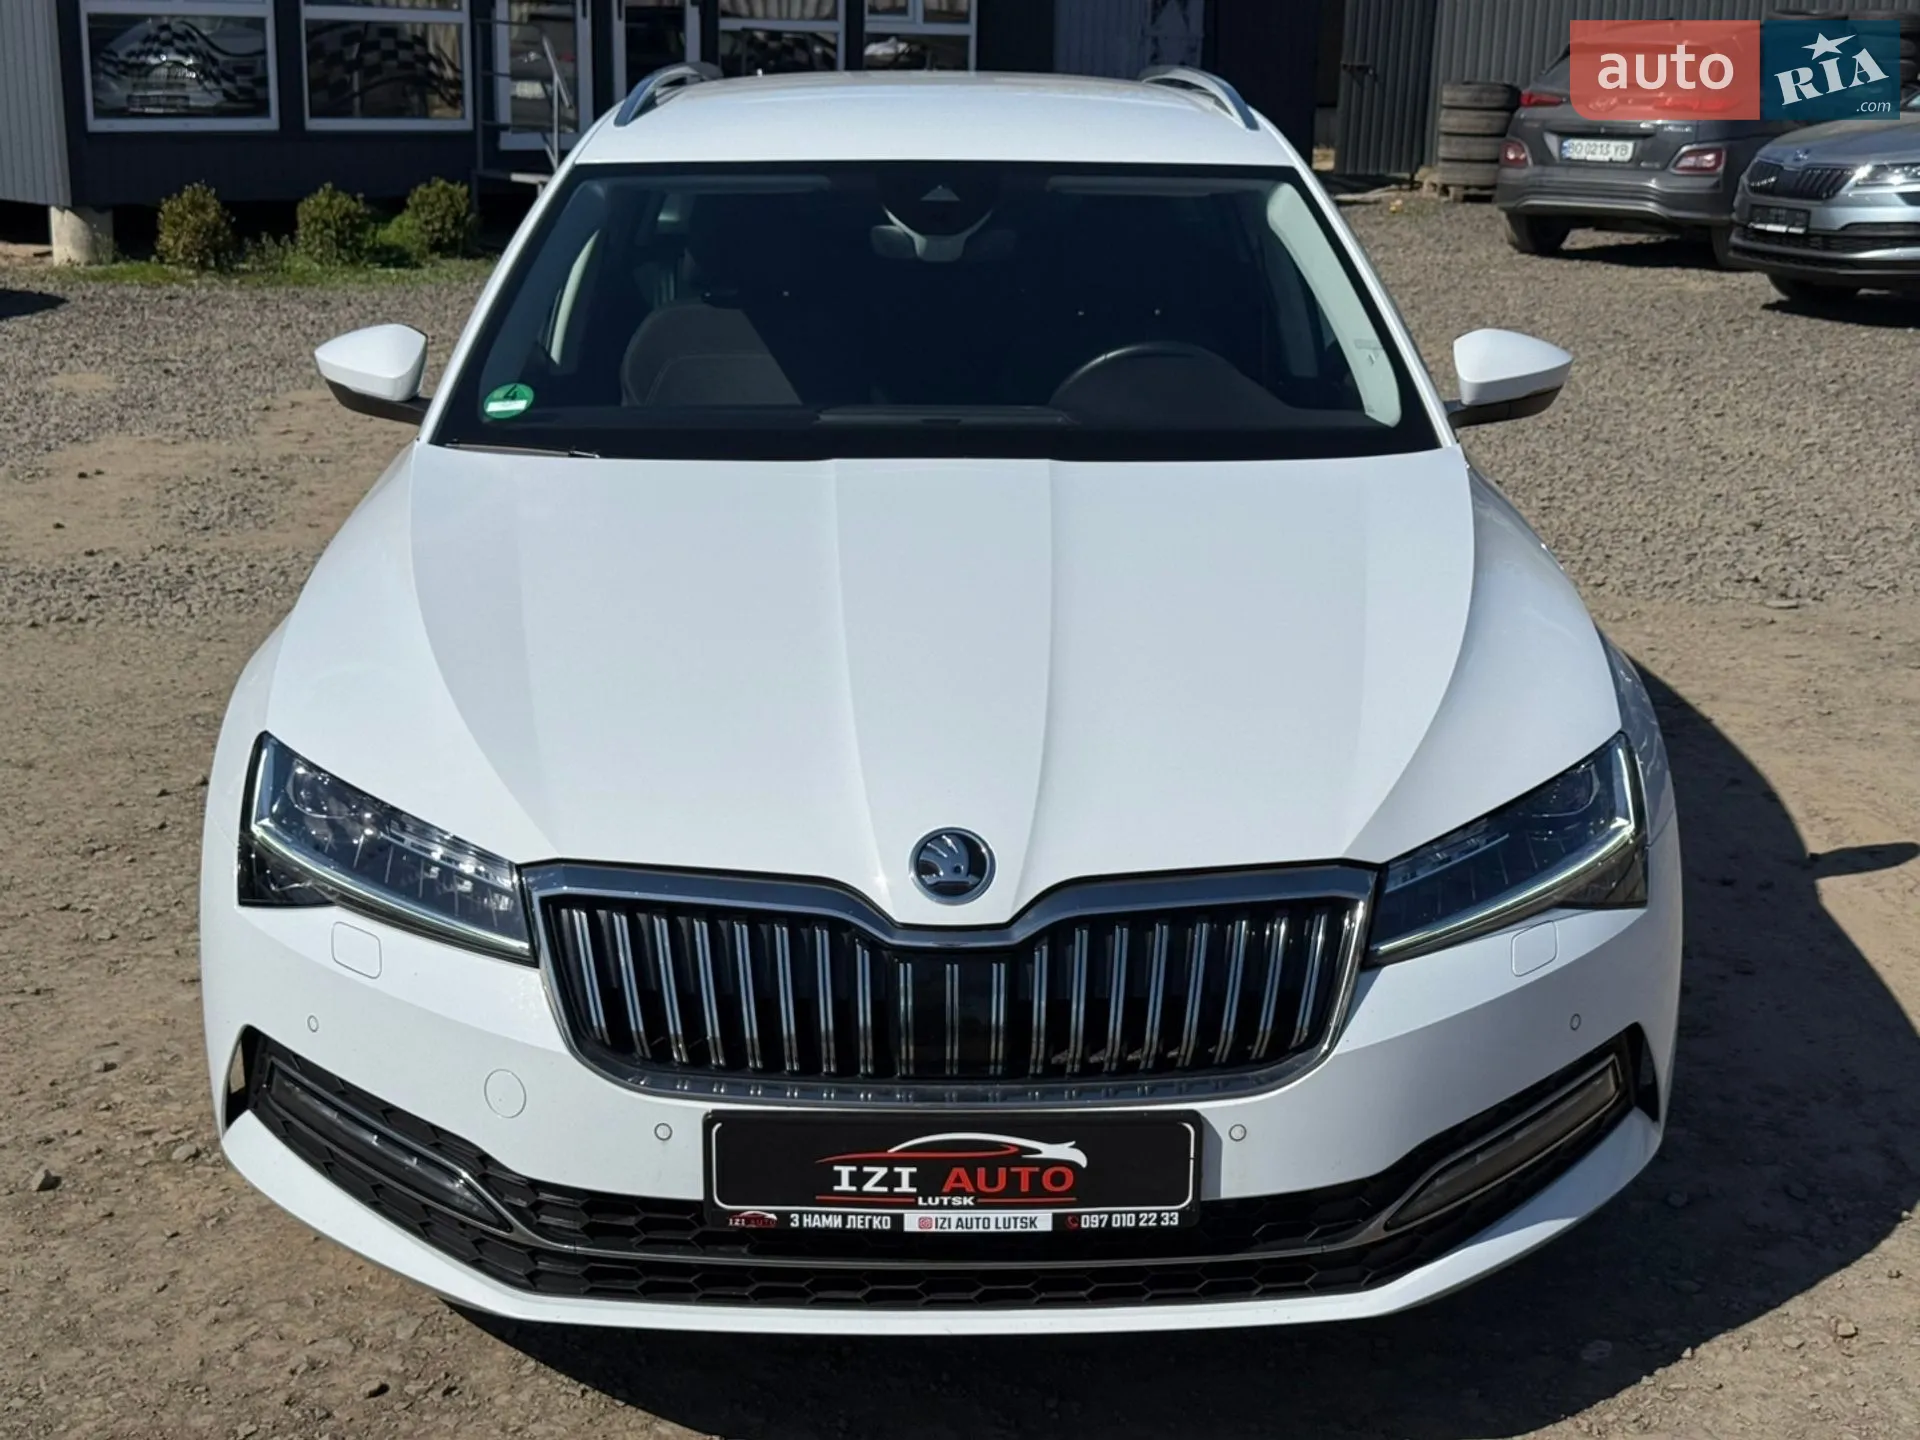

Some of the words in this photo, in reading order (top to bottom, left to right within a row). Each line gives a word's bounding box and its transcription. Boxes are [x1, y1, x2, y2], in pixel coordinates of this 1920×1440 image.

[503, 385, 518, 400] 4
[833, 1165, 917, 1193] IZI
[942, 1166, 1075, 1193] AUTO
[917, 1196, 975, 1206] LUTSK
[802, 1214, 842, 1229] НАМИ
[845, 1215, 891, 1229] ЛЕГКО
[934, 1216, 951, 1230] IZI
[955, 1216, 990, 1229] AUTO
[994, 1215, 1038, 1230] LUTSK
[1080, 1214, 1107, 1228] 097
[1111, 1213, 1135, 1227] 010
[1138, 1212, 1157, 1226] 22
[1160, 1211, 1179, 1226] 33
